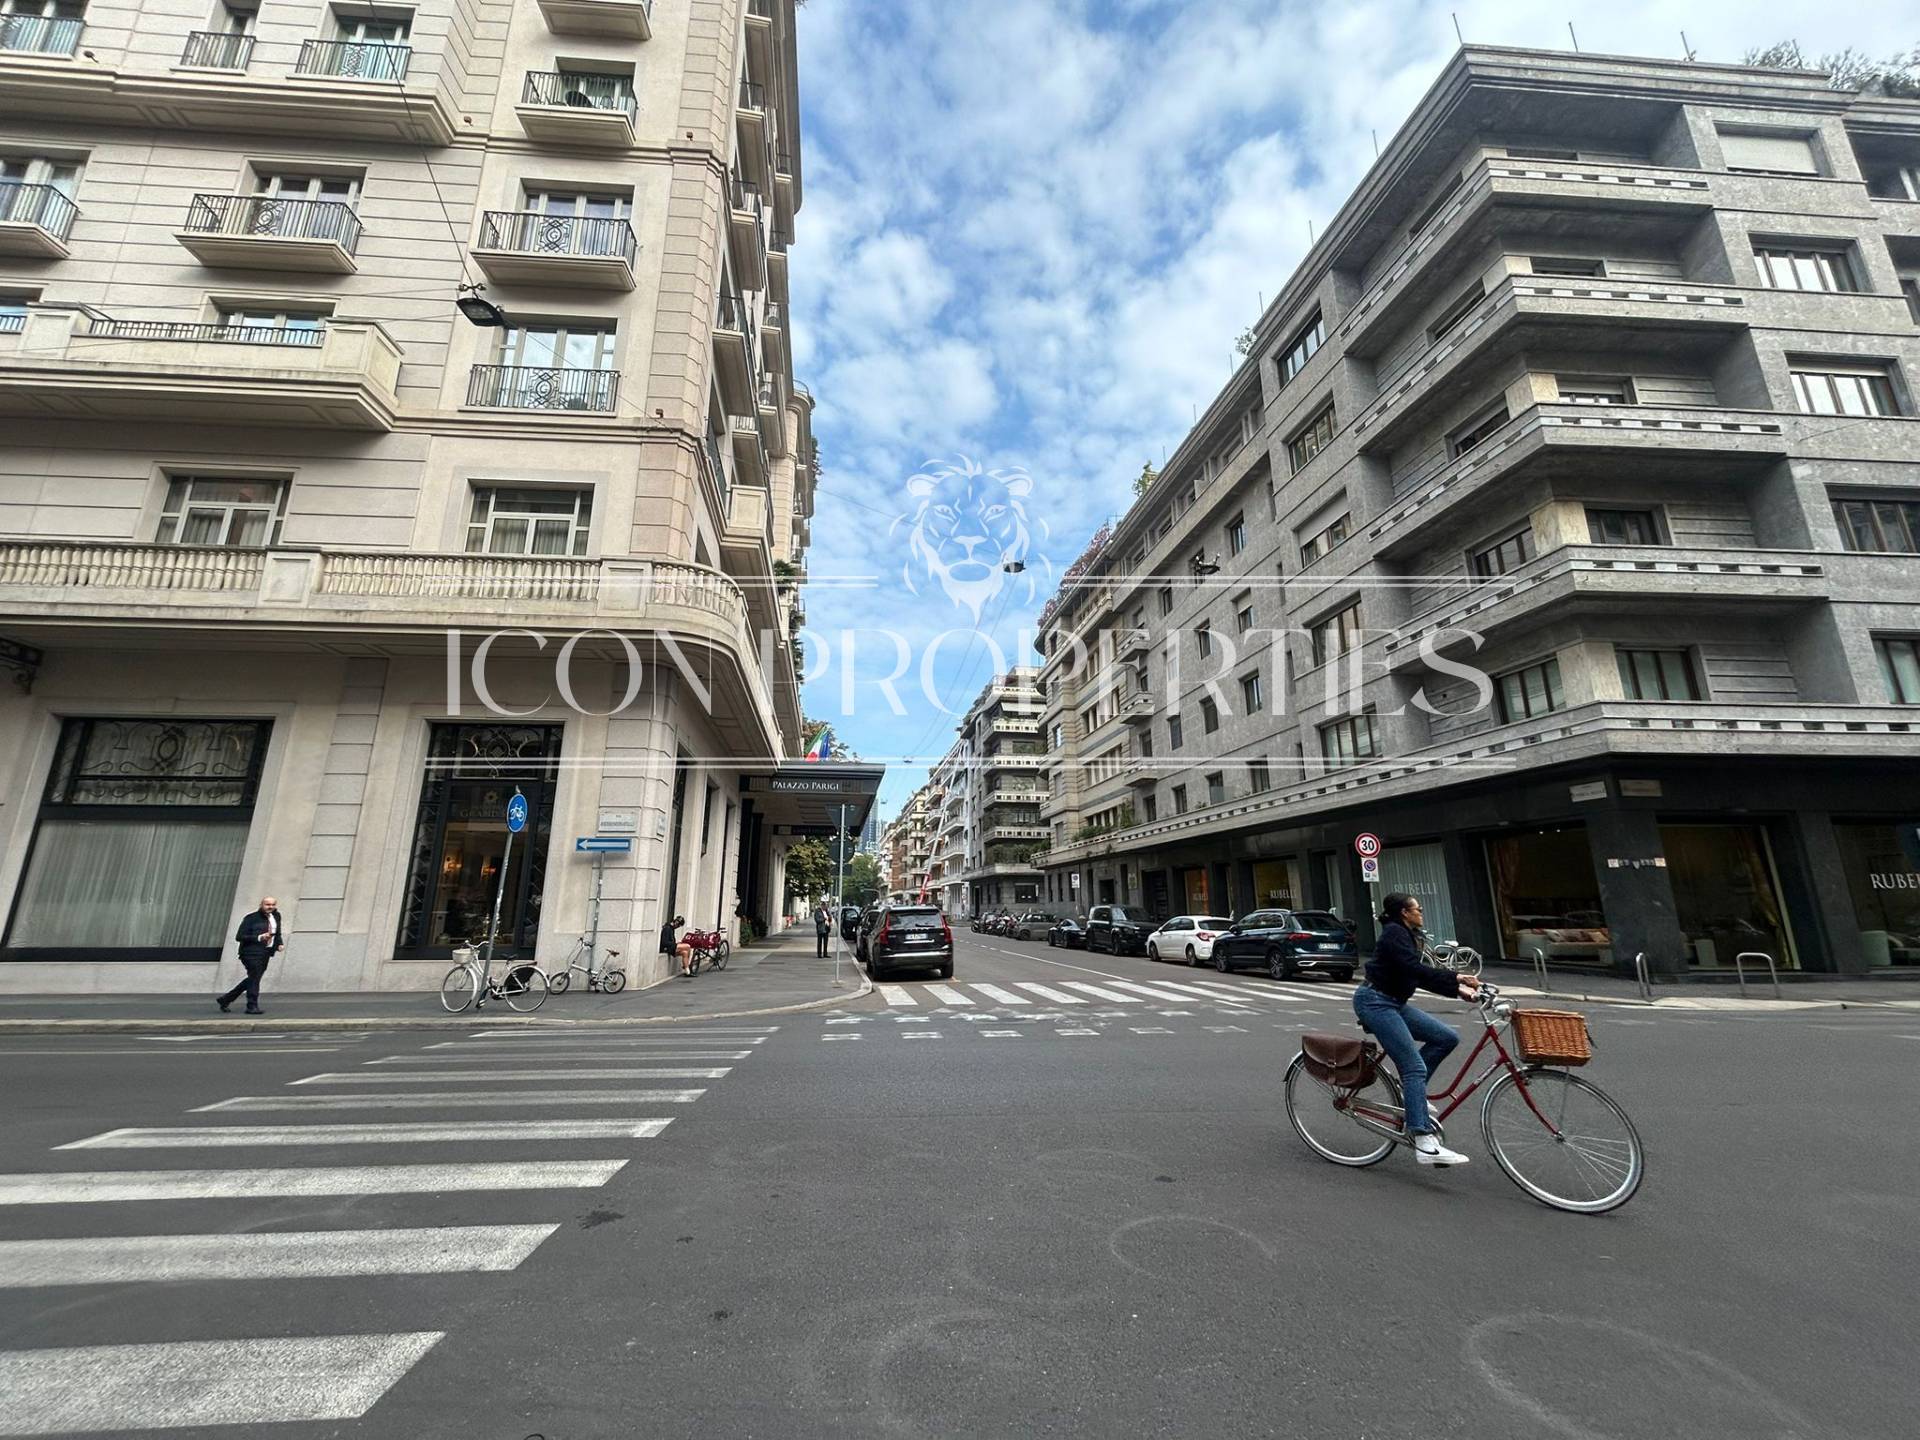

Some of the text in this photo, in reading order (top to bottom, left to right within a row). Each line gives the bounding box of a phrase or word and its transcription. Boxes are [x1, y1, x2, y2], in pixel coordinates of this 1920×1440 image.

[773, 781, 839, 792] PALAZZO PARIGI
[1361, 840, 1375, 851] 30
